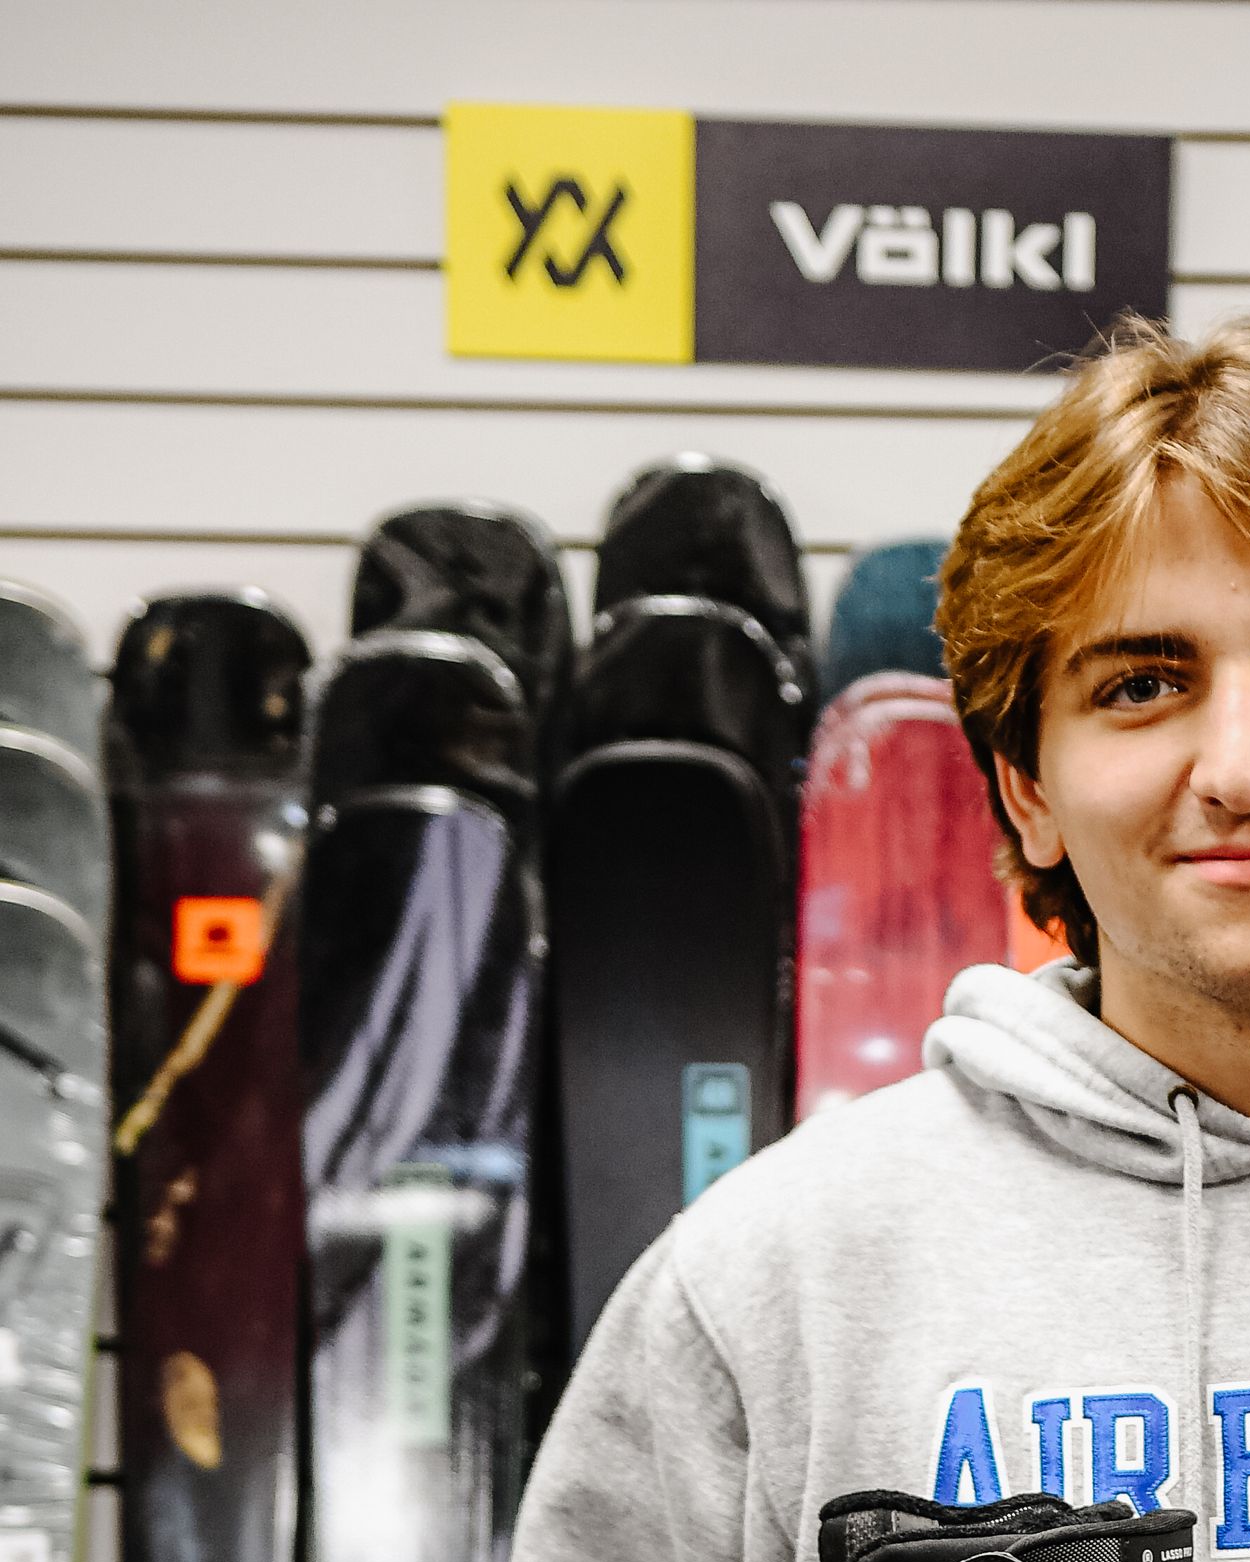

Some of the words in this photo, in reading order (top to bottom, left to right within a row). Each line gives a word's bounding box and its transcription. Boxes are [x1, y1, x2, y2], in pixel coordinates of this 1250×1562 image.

[769, 200, 1096, 292] Völkl
[931, 1385, 1173, 1517] AIR
[1161, 1548, 1183, 1561] LASSO
